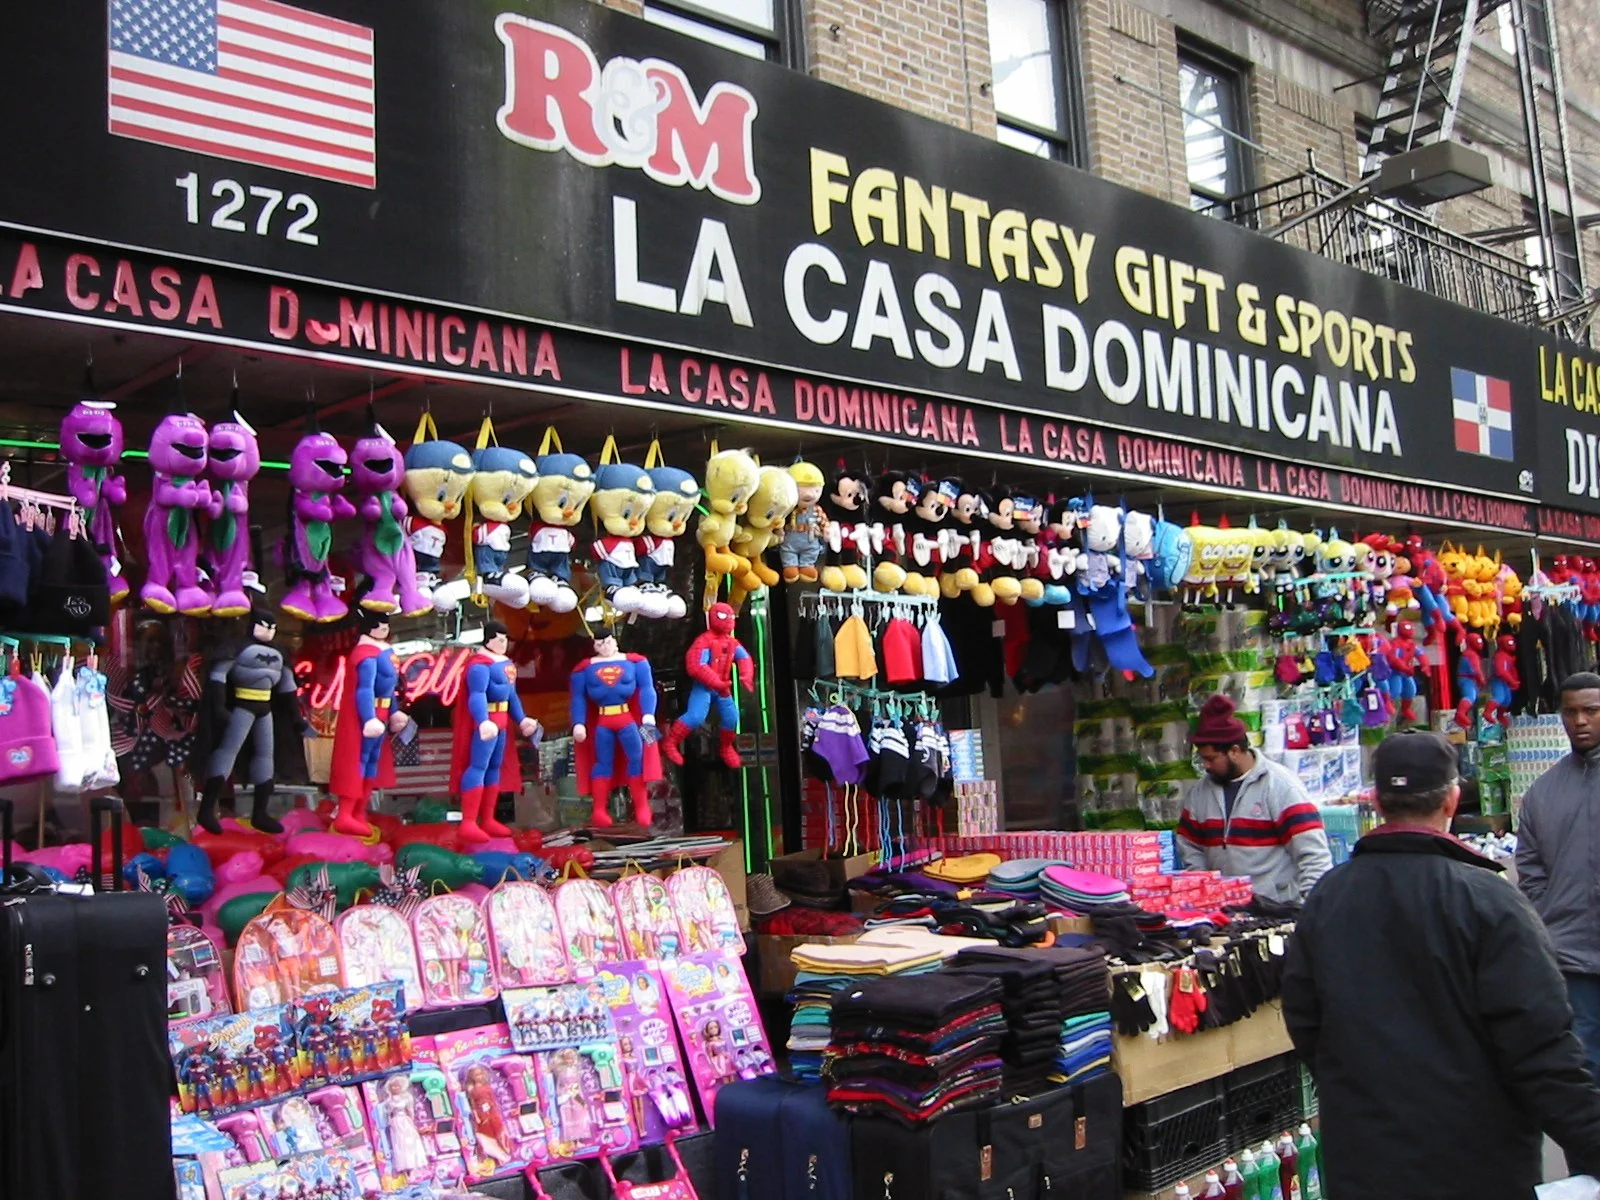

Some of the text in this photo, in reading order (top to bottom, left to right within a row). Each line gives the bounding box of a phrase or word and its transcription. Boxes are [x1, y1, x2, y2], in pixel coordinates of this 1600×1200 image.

[496, 14, 760, 204] R&M
[175, 171, 319, 246] 1272
[809, 146, 1418, 384] FANTASY GIFT & SPORTS
[0, 243, 44, 299] A
[65, 252, 223, 330] CASA
[619, 347, 671, 396] LA
[679, 358, 777, 416] CASA
[794, 378, 981, 447] DOMINICANA
[999, 413, 1034, 455] LA
[1042, 422, 1107, 466] CASA
[1117, 434, 1245, 487] DOMINICANA
[1256, 459, 1282, 493] LA
[1285, 465, 1330, 500] CASA
[1339, 476, 1430, 516] DOMINICANA
[1432, 489, 1450, 517] LA
[612, 195, 1404, 457] LA CASA DOMINICANA
[1538, 345, 1568, 407] LA
[1565, 427, 1600, 499] DI
